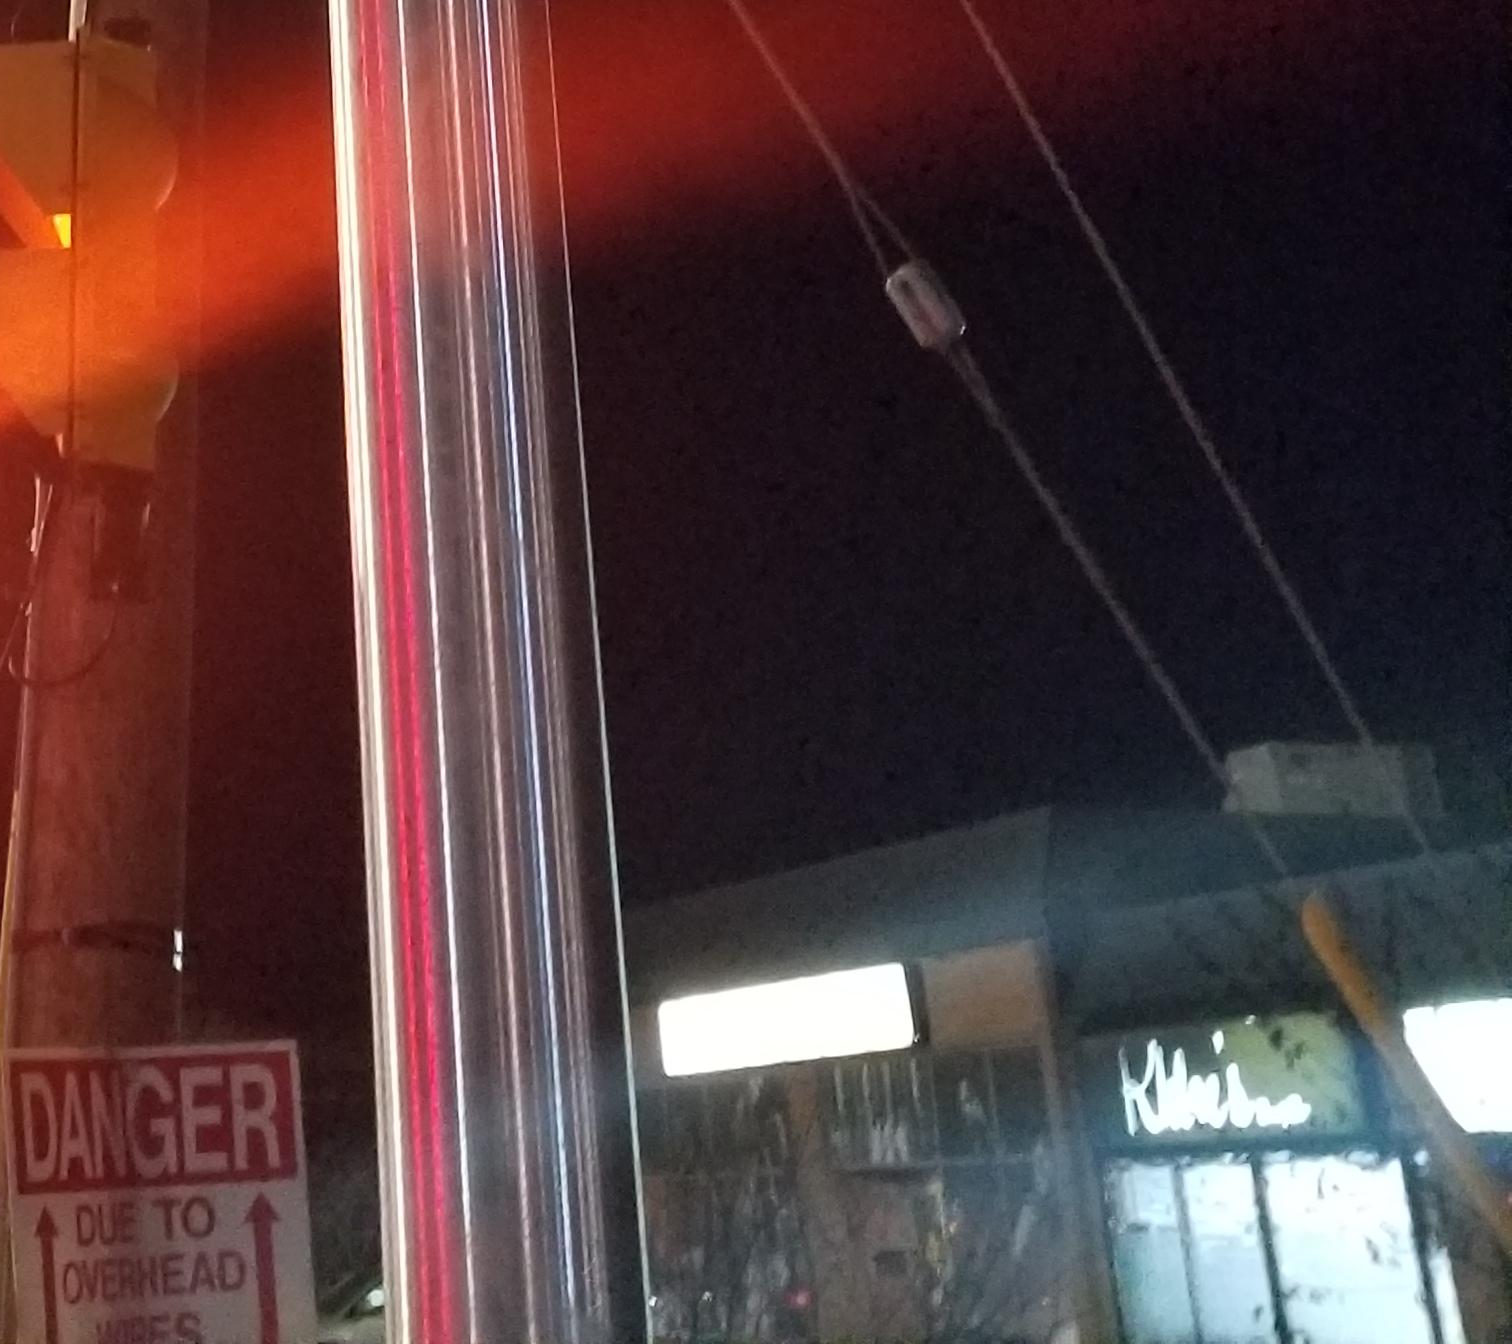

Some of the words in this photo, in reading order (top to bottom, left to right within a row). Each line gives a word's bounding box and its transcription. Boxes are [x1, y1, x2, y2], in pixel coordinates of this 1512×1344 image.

[19, 1064, 283, 1184] DANGER
[75, 1201, 138, 1248] DUE
[153, 1196, 217, 1242] TO
[61, 1250, 248, 1305] OVERHEAD
